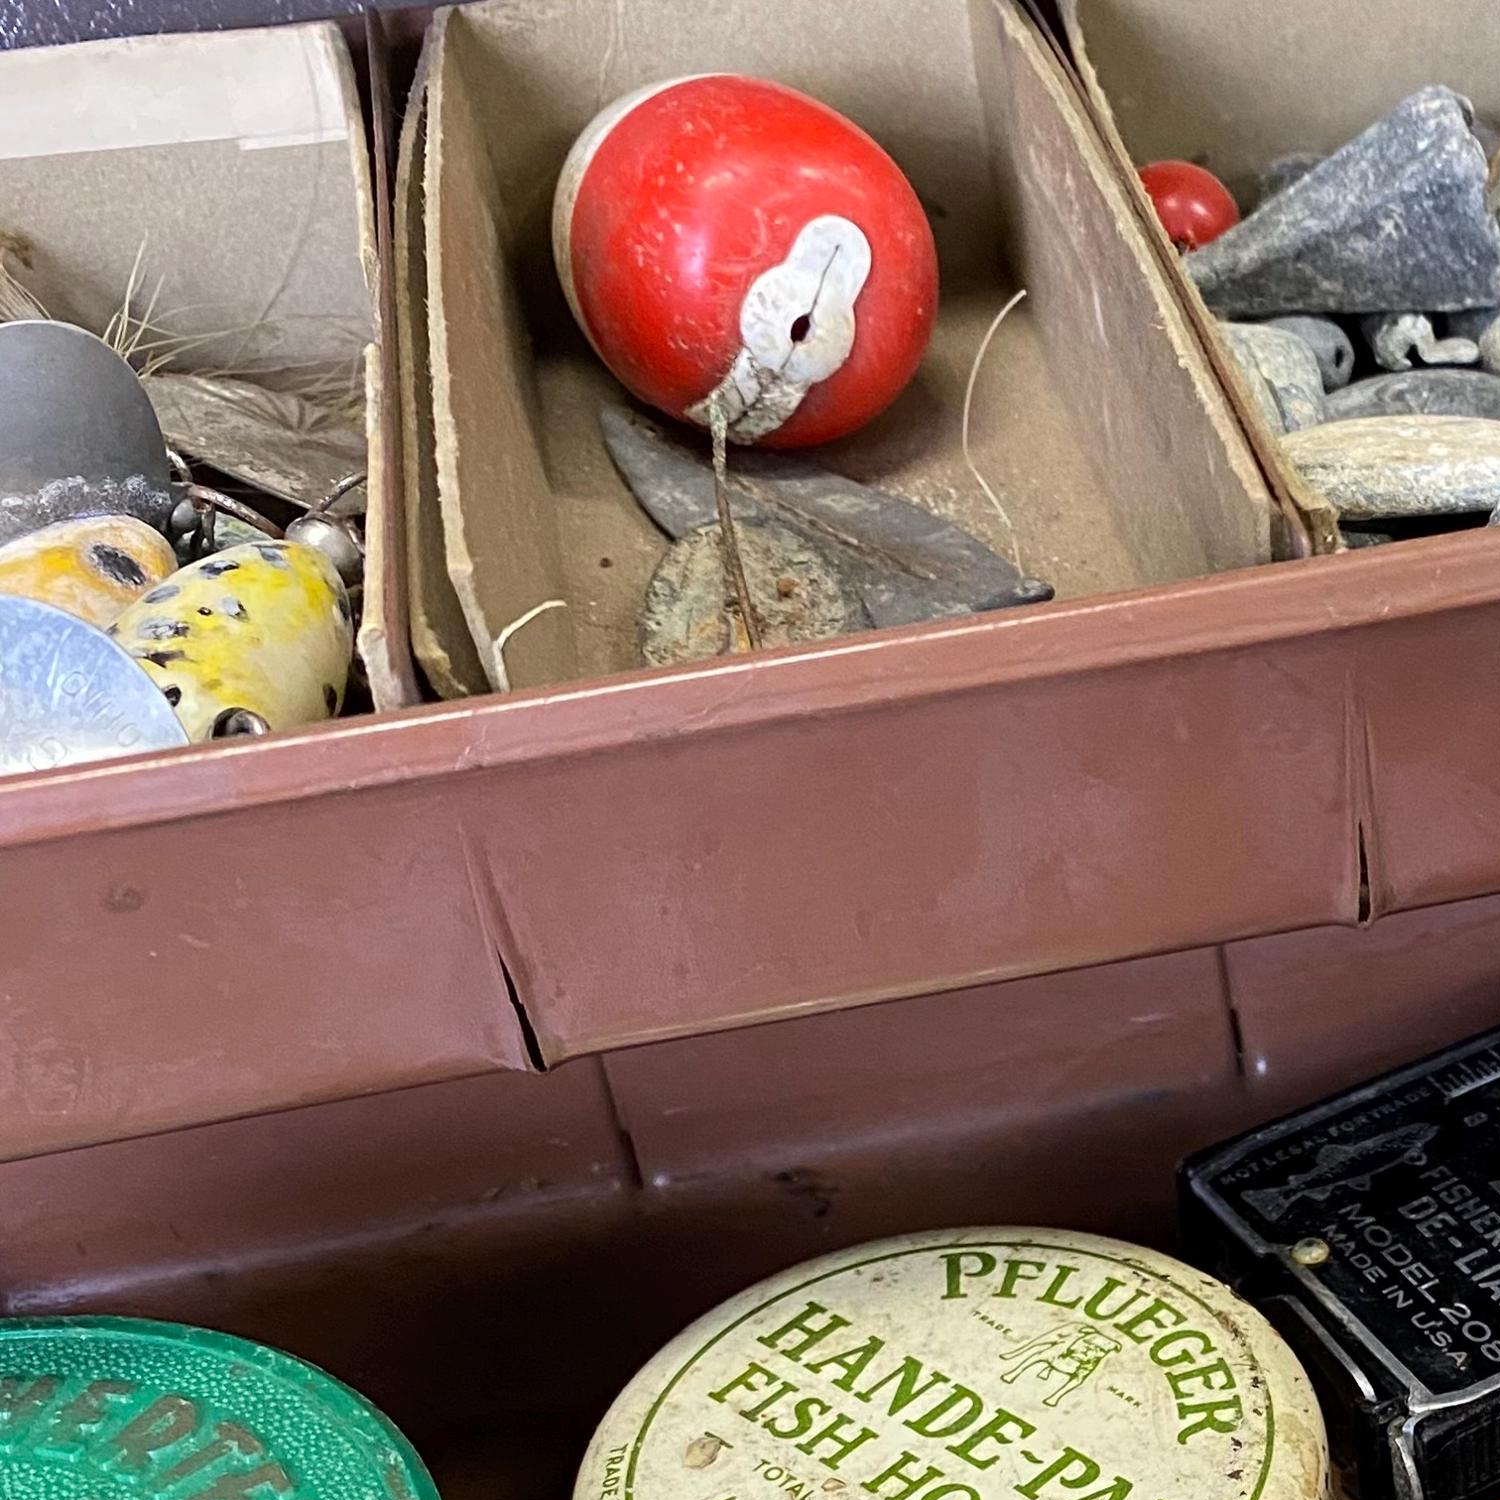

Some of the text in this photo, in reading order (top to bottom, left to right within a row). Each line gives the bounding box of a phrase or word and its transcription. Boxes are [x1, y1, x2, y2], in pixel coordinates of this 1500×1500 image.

[1219, 1087, 1432, 1185] NOT LEGAL FOR TRADE
[1321, 1223, 1388, 1283] MADE
[1382, 1284, 1413, 1309] IN
[1338, 1203, 1440, 1303] MODEL
[939, 1251, 1243, 1445] PFLUEGER
[971, 1309, 1143, 1408] TRADE MARK
[708, 1362, 879, 1470] FISH
[599, 1443, 629, 1498] TRADE
